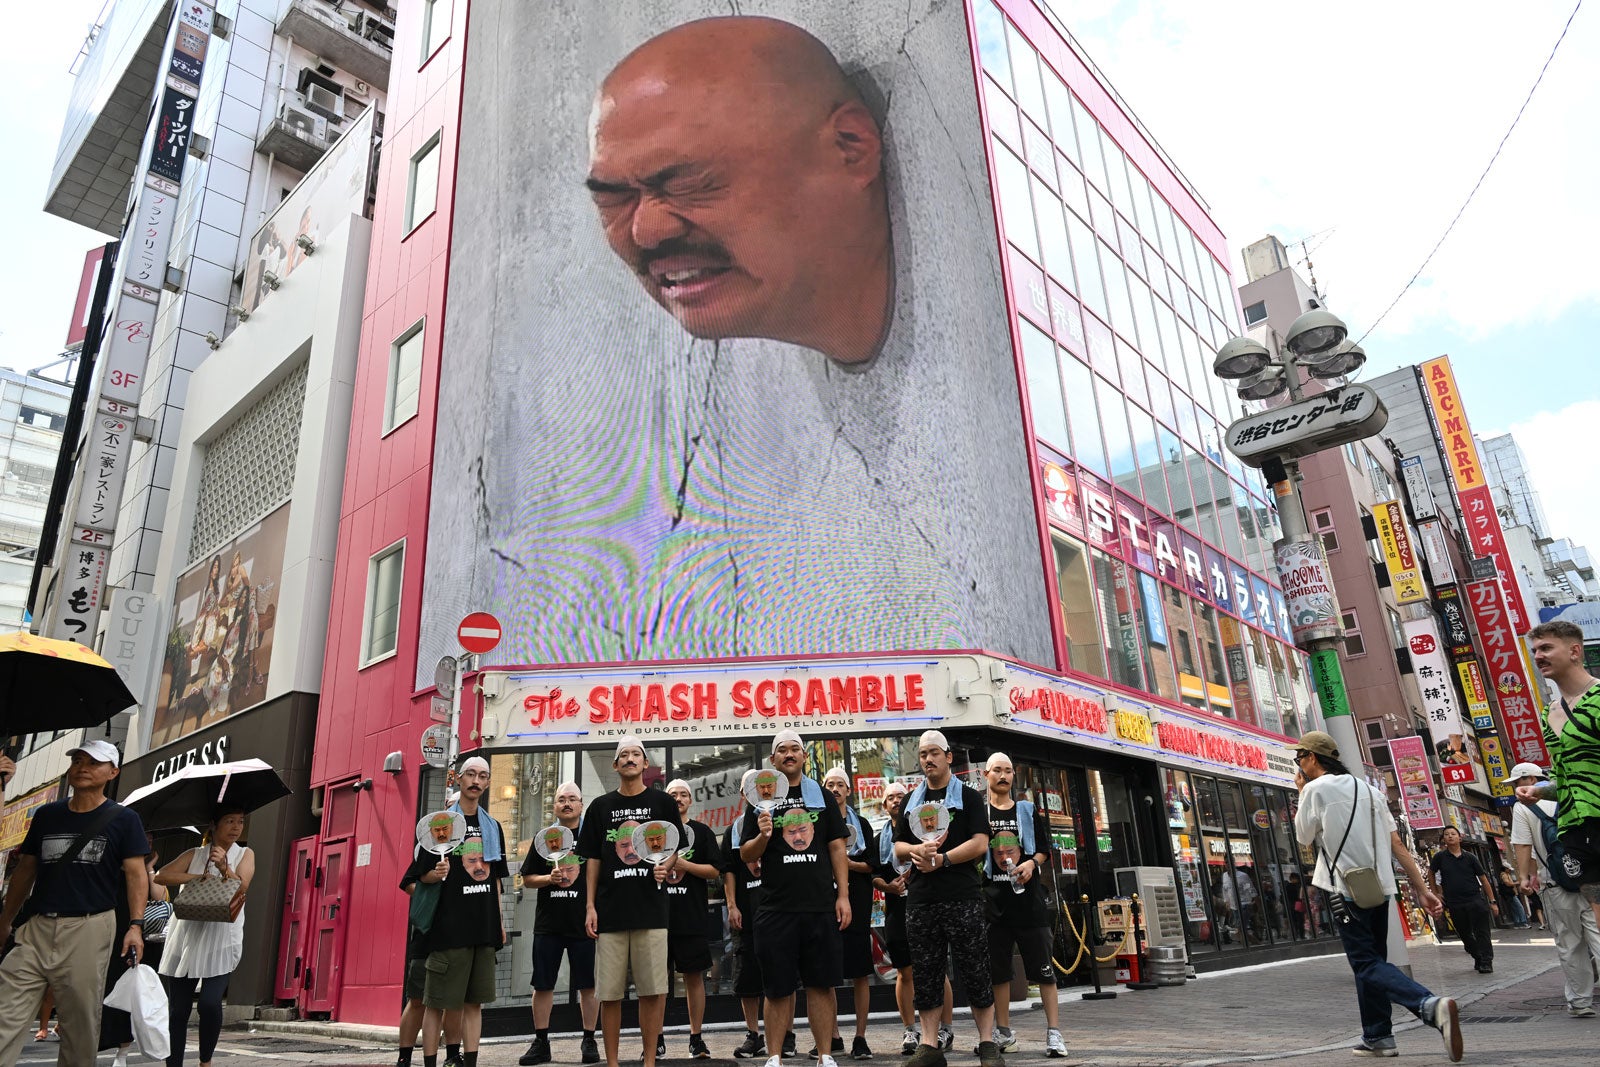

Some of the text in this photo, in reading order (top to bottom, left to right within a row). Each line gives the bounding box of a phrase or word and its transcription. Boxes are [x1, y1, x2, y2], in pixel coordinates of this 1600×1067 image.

[168, 99, 193, 158] ダーツバー
[153, 181, 173, 191] 4F
[138, 195, 165, 280] ブランクリニック
[131, 284, 152, 297] 3F
[110, 370, 139, 388] 3F
[107, 401, 129, 414] 3F
[1234, 392, 1365, 446] 渋谷センター街
[90, 431, 120, 525] 不二家レストラン
[81, 529, 104, 542] 2F
[1389, 505, 1412, 567] 全身もみほぐし
[63, 551, 95, 642] 博多もつ
[1211, 561, 1289, 634] カラオケ
[1290, 584, 1330, 599] SHIBUYA
[1473, 583, 1515, 669] カラオケ
[524, 674, 925, 726] The SMASH SCRAMBLE
[1419, 666, 1447, 722] 麻辣湯
[598, 718, 855, 736] NEW BURGERS, TIMELESS DELICIOUS
[1476, 718, 1489, 726] 2F
[1501, 697, 1544, 762] 歌広場
[1451, 769, 1466, 780] B1
[783, 854, 817, 863] DMM TV
[614, 868, 649, 878] DMM TV
[463, 884, 486, 894] DMM
